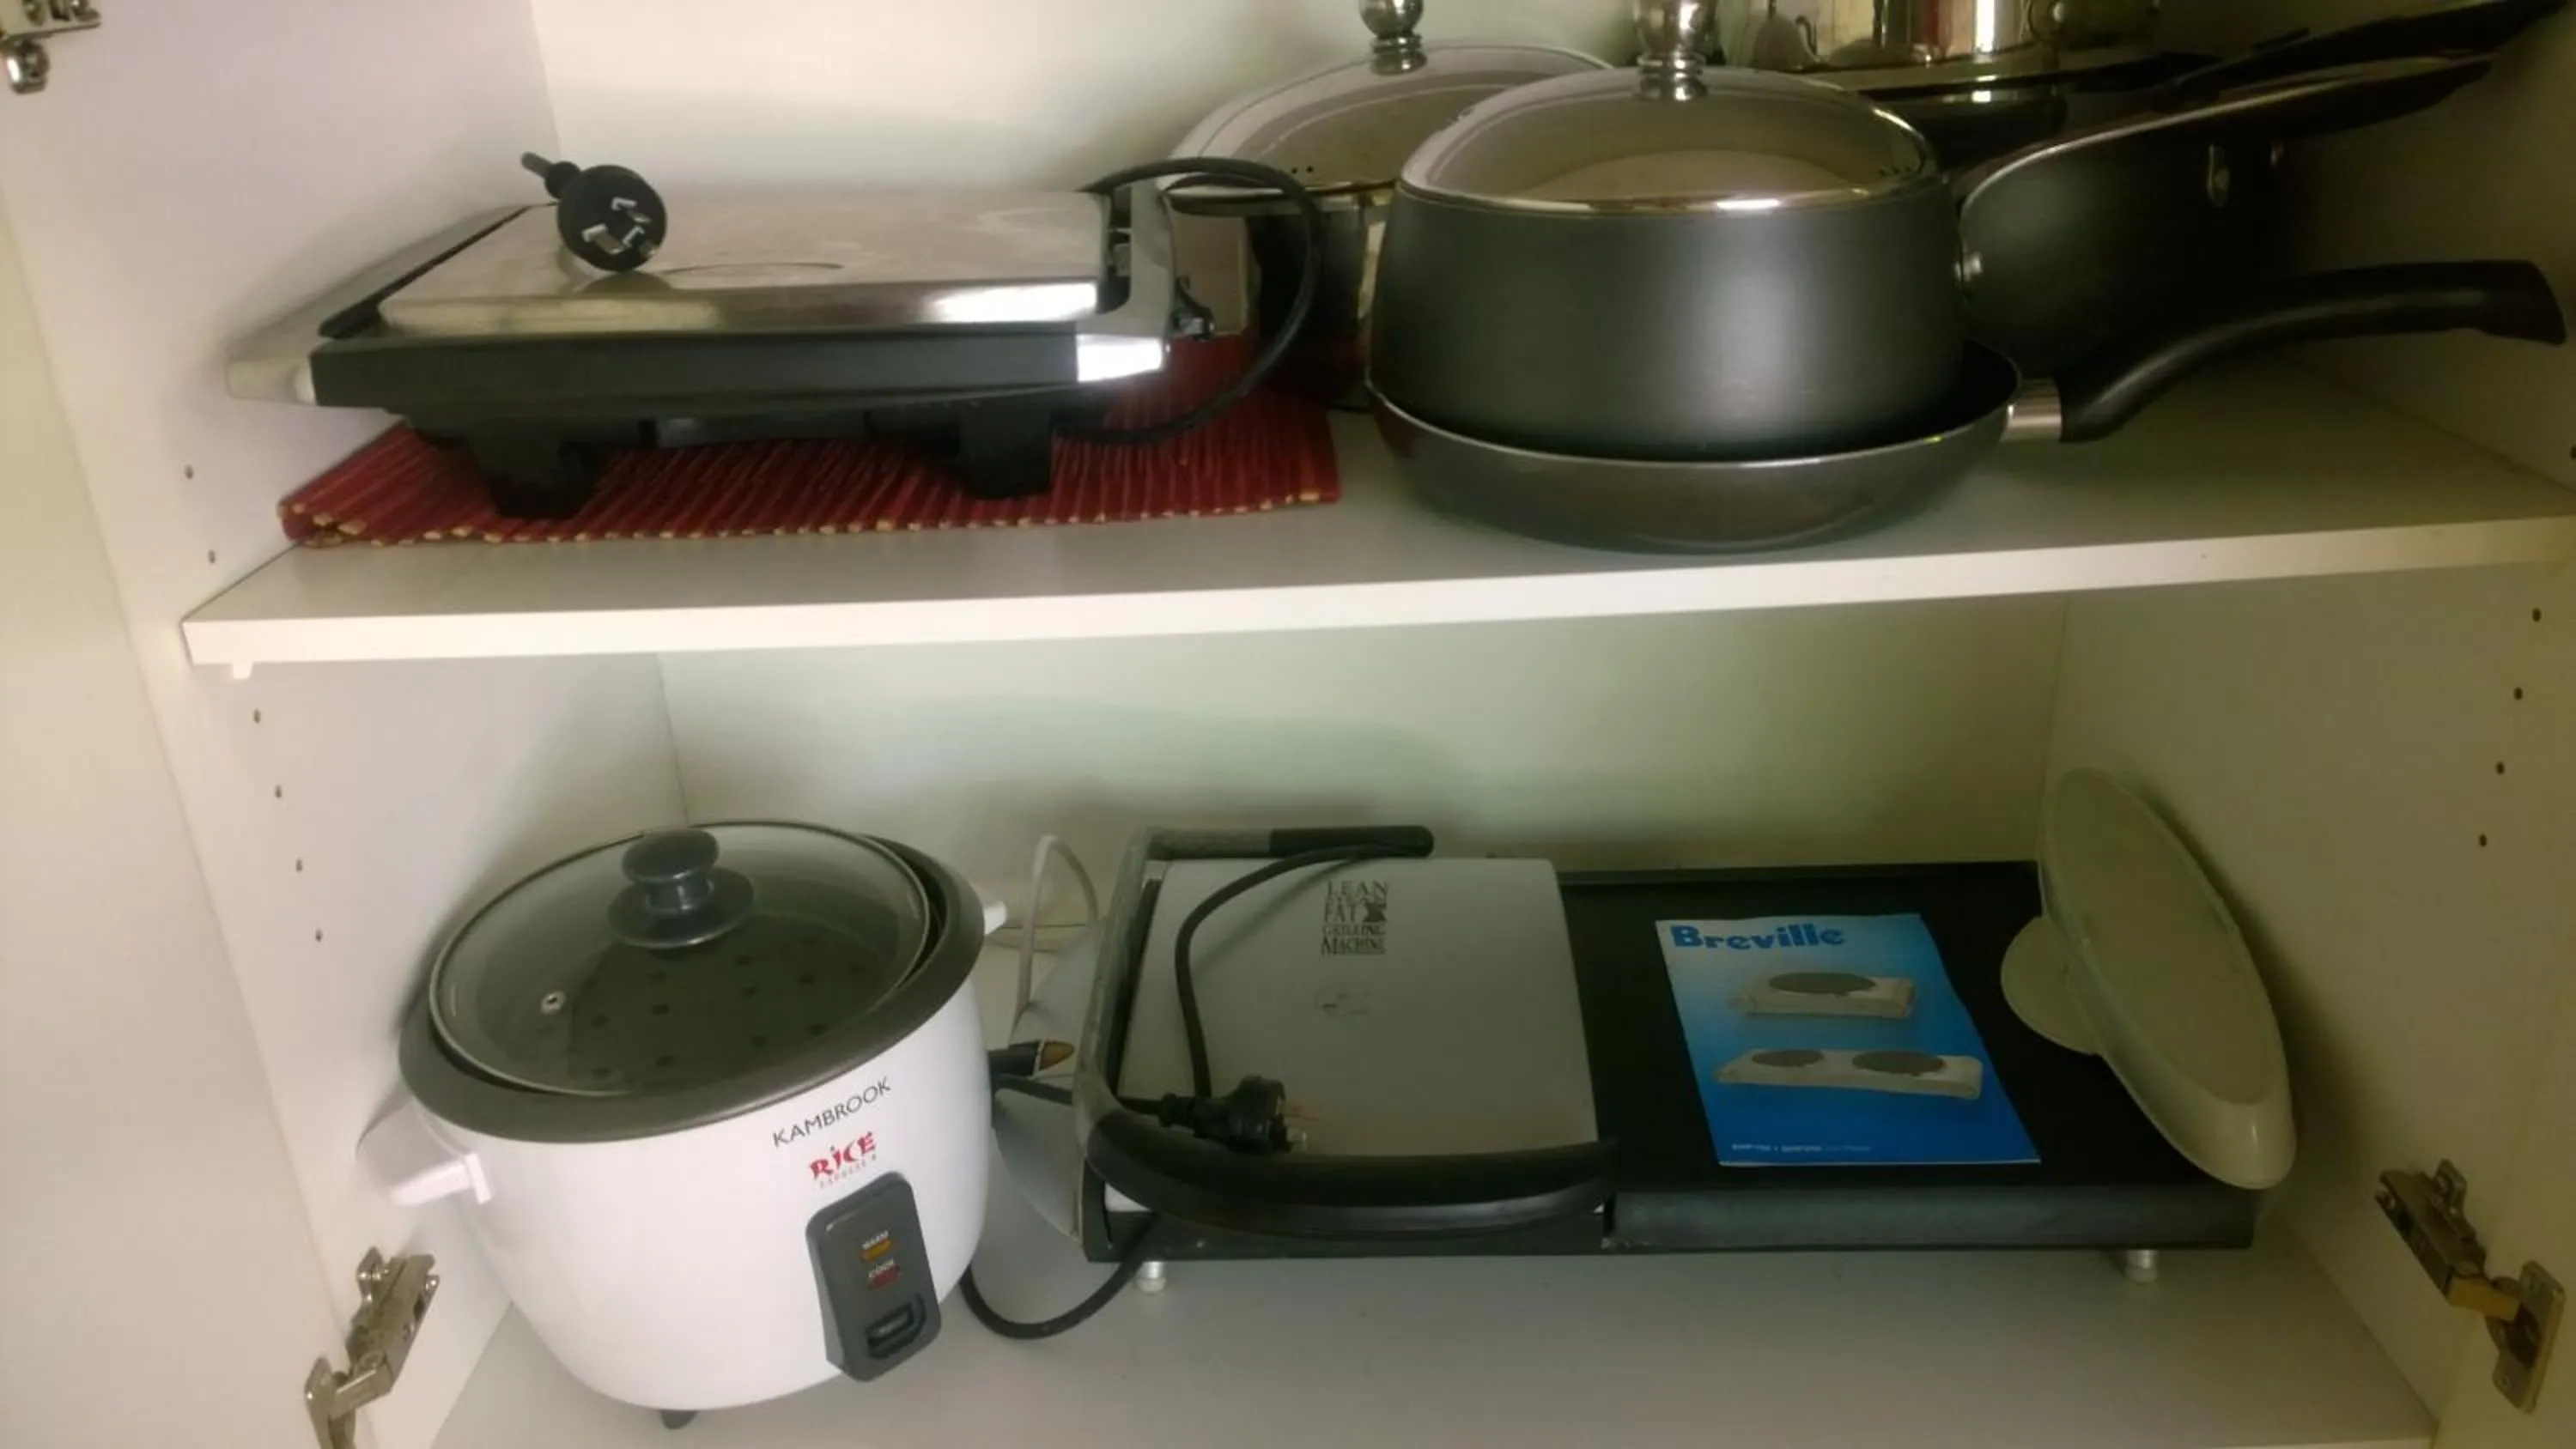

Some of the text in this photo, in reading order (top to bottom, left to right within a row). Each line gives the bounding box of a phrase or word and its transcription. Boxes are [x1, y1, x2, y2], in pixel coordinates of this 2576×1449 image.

[1327, 880, 1388, 894] LEAN
[1324, 902, 1358, 922] FAT
[1670, 924, 1845, 950] Breville
[773, 1076, 891, 1148] KAMBROOK
